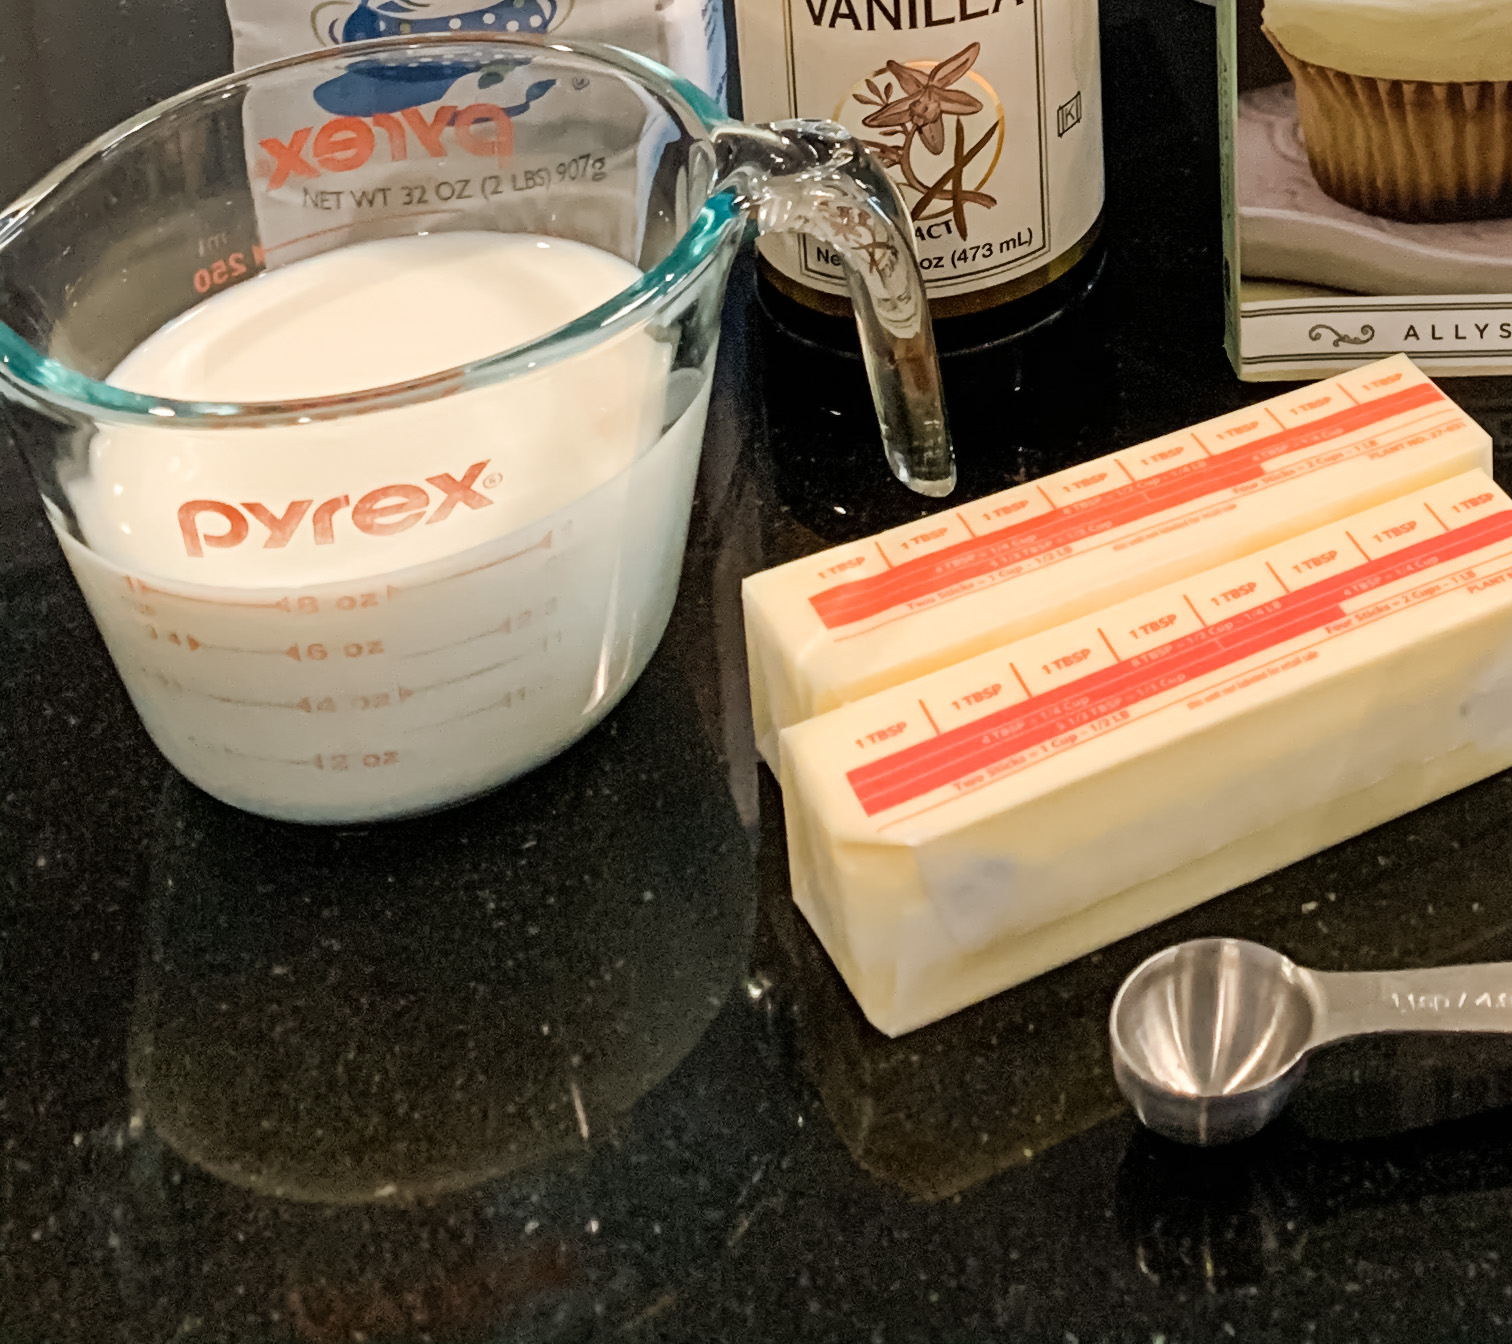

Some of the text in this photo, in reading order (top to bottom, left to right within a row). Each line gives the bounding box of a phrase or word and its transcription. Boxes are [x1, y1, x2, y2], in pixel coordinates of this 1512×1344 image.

[302, 187, 343, 210] NET
[349, 187, 392, 209] WT
[401, 185, 429, 206] 32
[436, 179, 473, 201] OZ
[480, 174, 504, 202] (2
[512, 169, 552, 192] LBS)
[816, 227, 1034, 270] Ne oz (473 mL)
[176, 458, 497, 558] pyrex
[1460, 491, 1496, 510] TBSP
[1382, 520, 1418, 540] TBSP
[1302, 549, 1338, 572] TBSP
[1221, 581, 1258, 604] TBSP
[1139, 613, 1178, 636] TBSP
[1052, 647, 1092, 670] TBSP
[962, 682, 1003, 707] TBSP
[866, 720, 908, 745] TBSP
